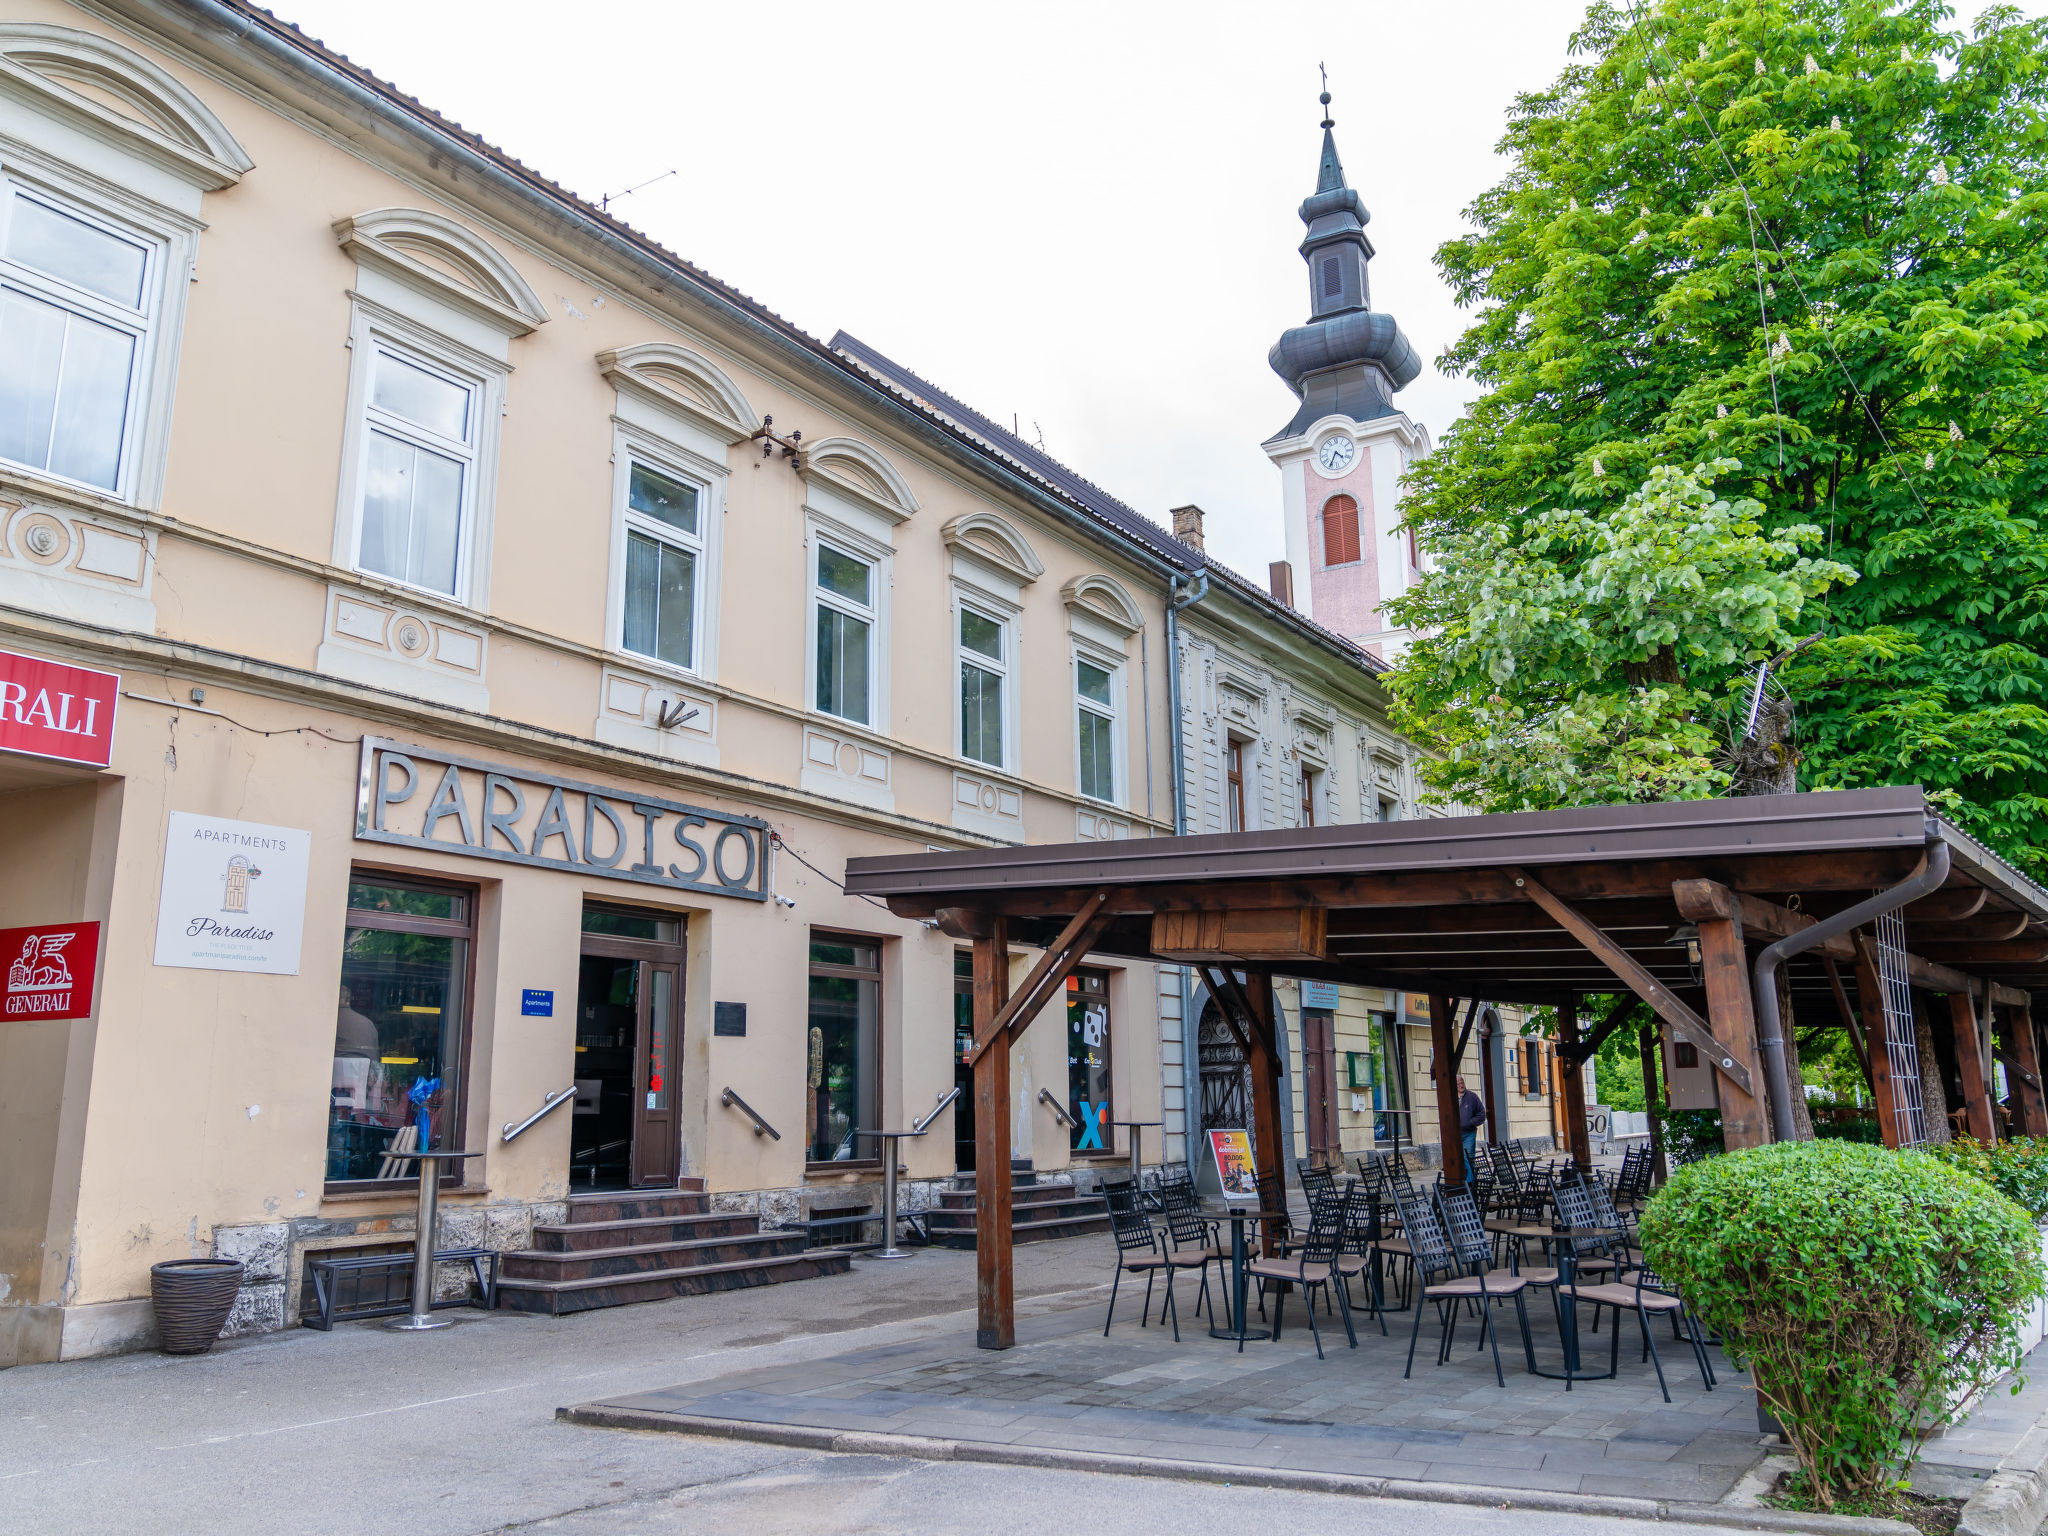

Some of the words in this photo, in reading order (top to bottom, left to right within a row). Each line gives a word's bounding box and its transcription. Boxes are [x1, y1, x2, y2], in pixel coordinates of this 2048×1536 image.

[0, 680, 101, 737] RALI
[375, 751, 756, 888] PARADISO
[193, 828, 287, 851] APARTMENTS
[186, 917, 274, 941] Paradiso
[5, 992, 72, 1014] GENERALI
